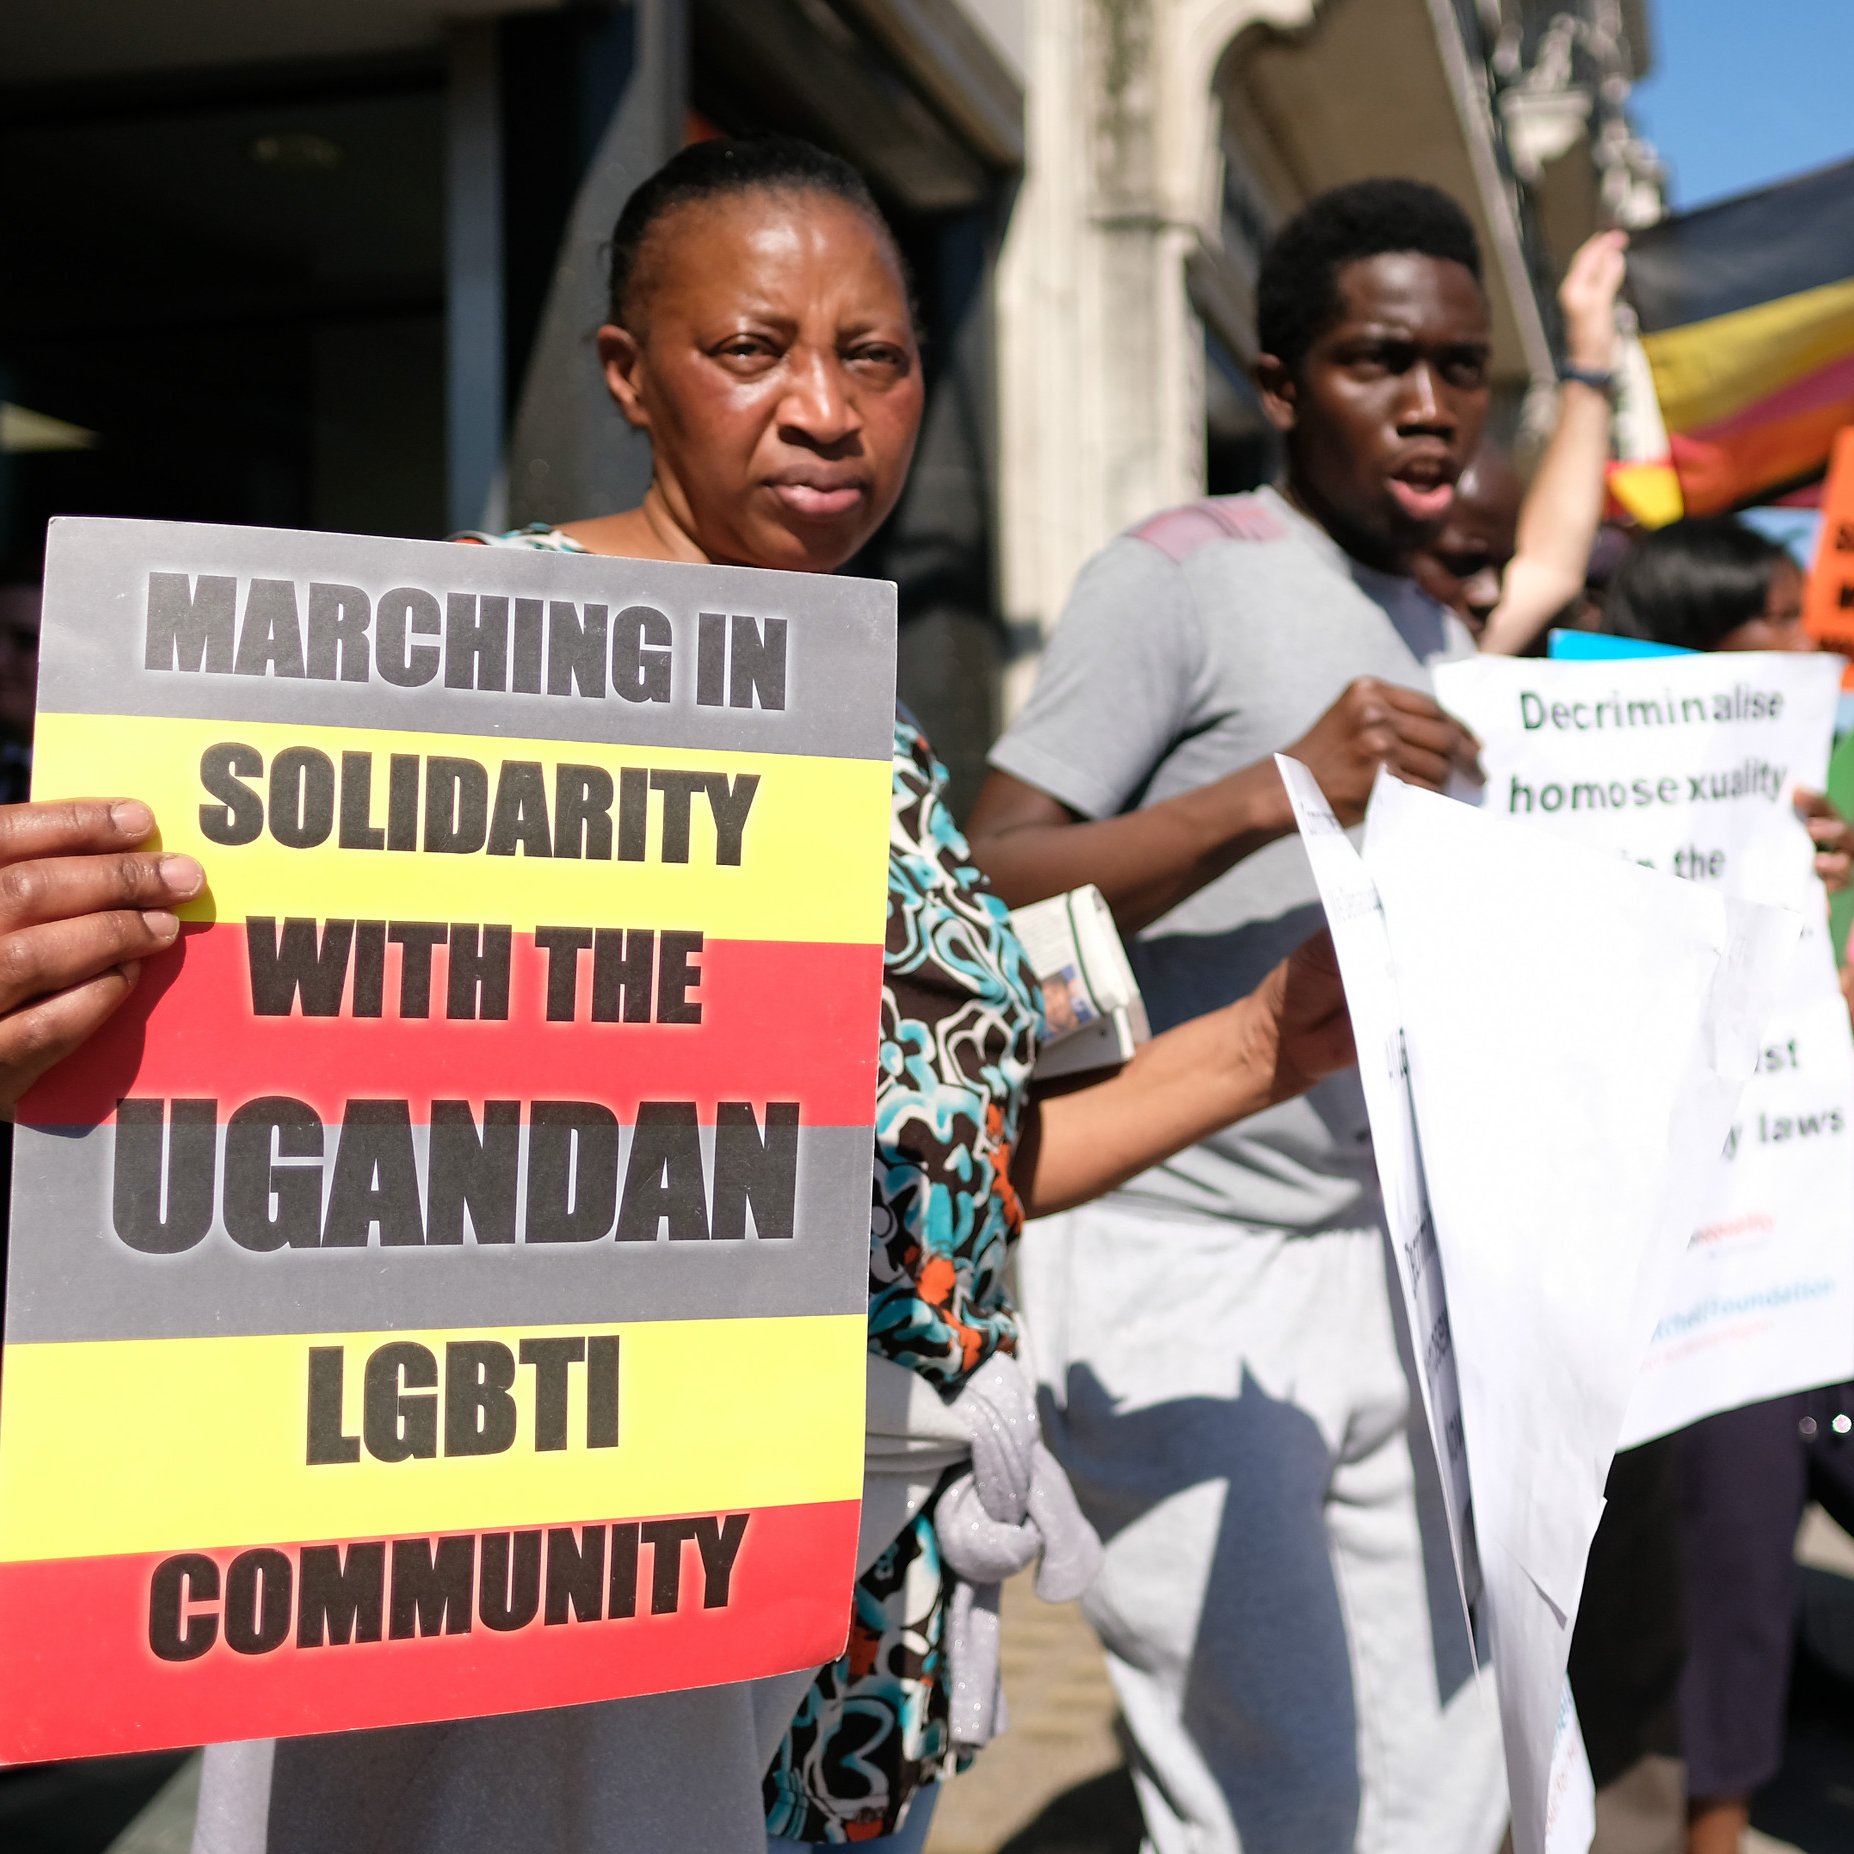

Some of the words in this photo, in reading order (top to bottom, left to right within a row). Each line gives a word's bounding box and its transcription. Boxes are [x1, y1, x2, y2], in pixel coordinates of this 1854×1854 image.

[145, 572, 674, 704] MARCHING
[696, 612, 788, 712] IN
[1519, 684, 1785, 731] Decriminalise
[199, 742, 762, 867] SOLIDARITY
[1509, 758, 1788, 815] homosexuality
[1673, 843, 1726, 881] the
[245, 915, 513, 1021] WITH
[535, 925, 705, 1026] THE
[112, 1096, 801, 1255] UGANDAN
[1758, 1106, 1845, 1144] laws
[306, 1335, 621, 1467] LGBTI
[148, 1514, 751, 1662] COMMUNITY
